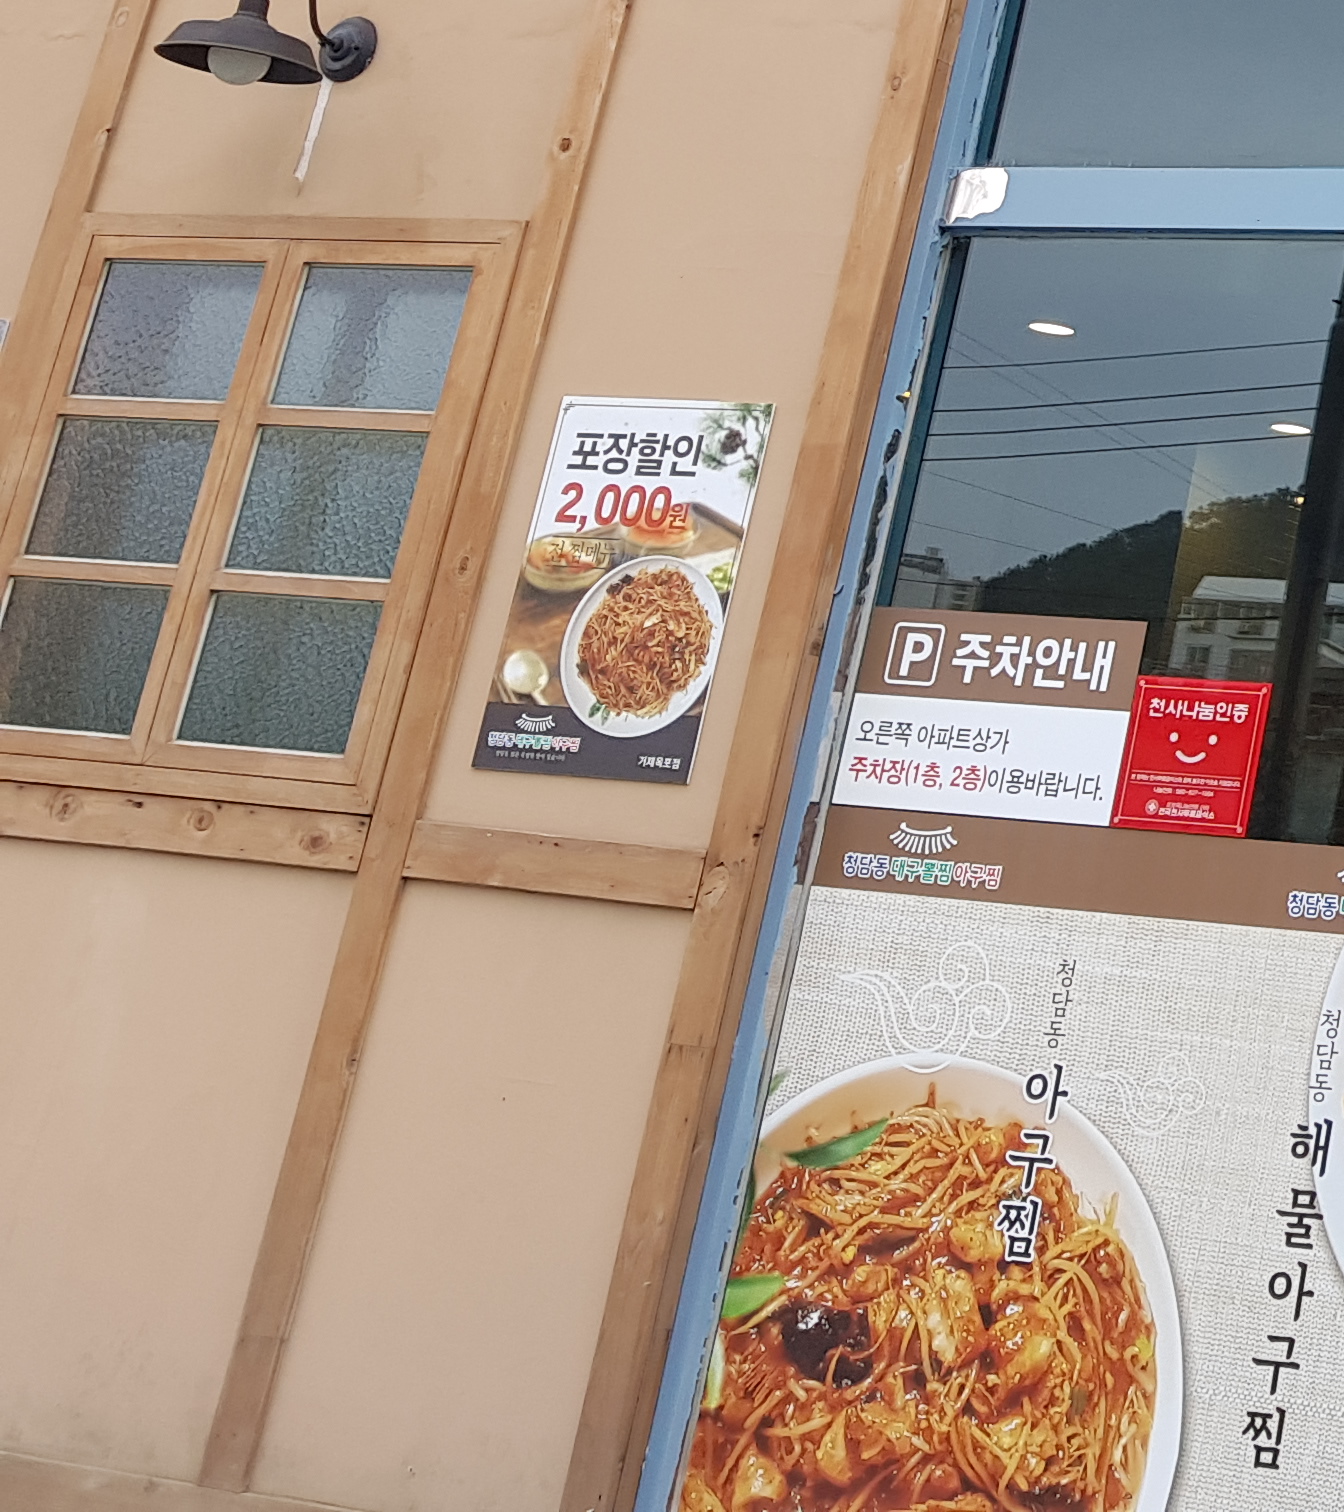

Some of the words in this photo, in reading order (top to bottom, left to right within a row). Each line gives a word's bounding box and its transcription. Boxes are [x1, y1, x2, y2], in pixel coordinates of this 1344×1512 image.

[566, 431, 704, 478] 포장할인
[555, 481, 689, 533] 2,000원
[899, 630, 936, 677] P
[951, 631, 1116, 692] 주차안내
[1149, 697, 1250, 724] 천사나눔인증
[855, 719, 913, 747] 오른쪽
[917, 724, 1010, 755] 아파트상가
[848, 755, 944, 792] 주차장(1층,
[950, 763, 1104, 802] 2층)이용바랍니다.
[843, 851, 889, 880] 청담동
[890, 857, 953, 886] 대구뽈찜
[952, 862, 1002, 890] 아구찜
[1288, 891, 1338, 920] 청담동
[1042, 958, 1079, 1049] 청담동
[1308, 1007, 1343, 1104] 청담동
[996, 1062, 1068, 1265] 아구찜
[1241, 1117, 1335, 1471] 해물아구찜
